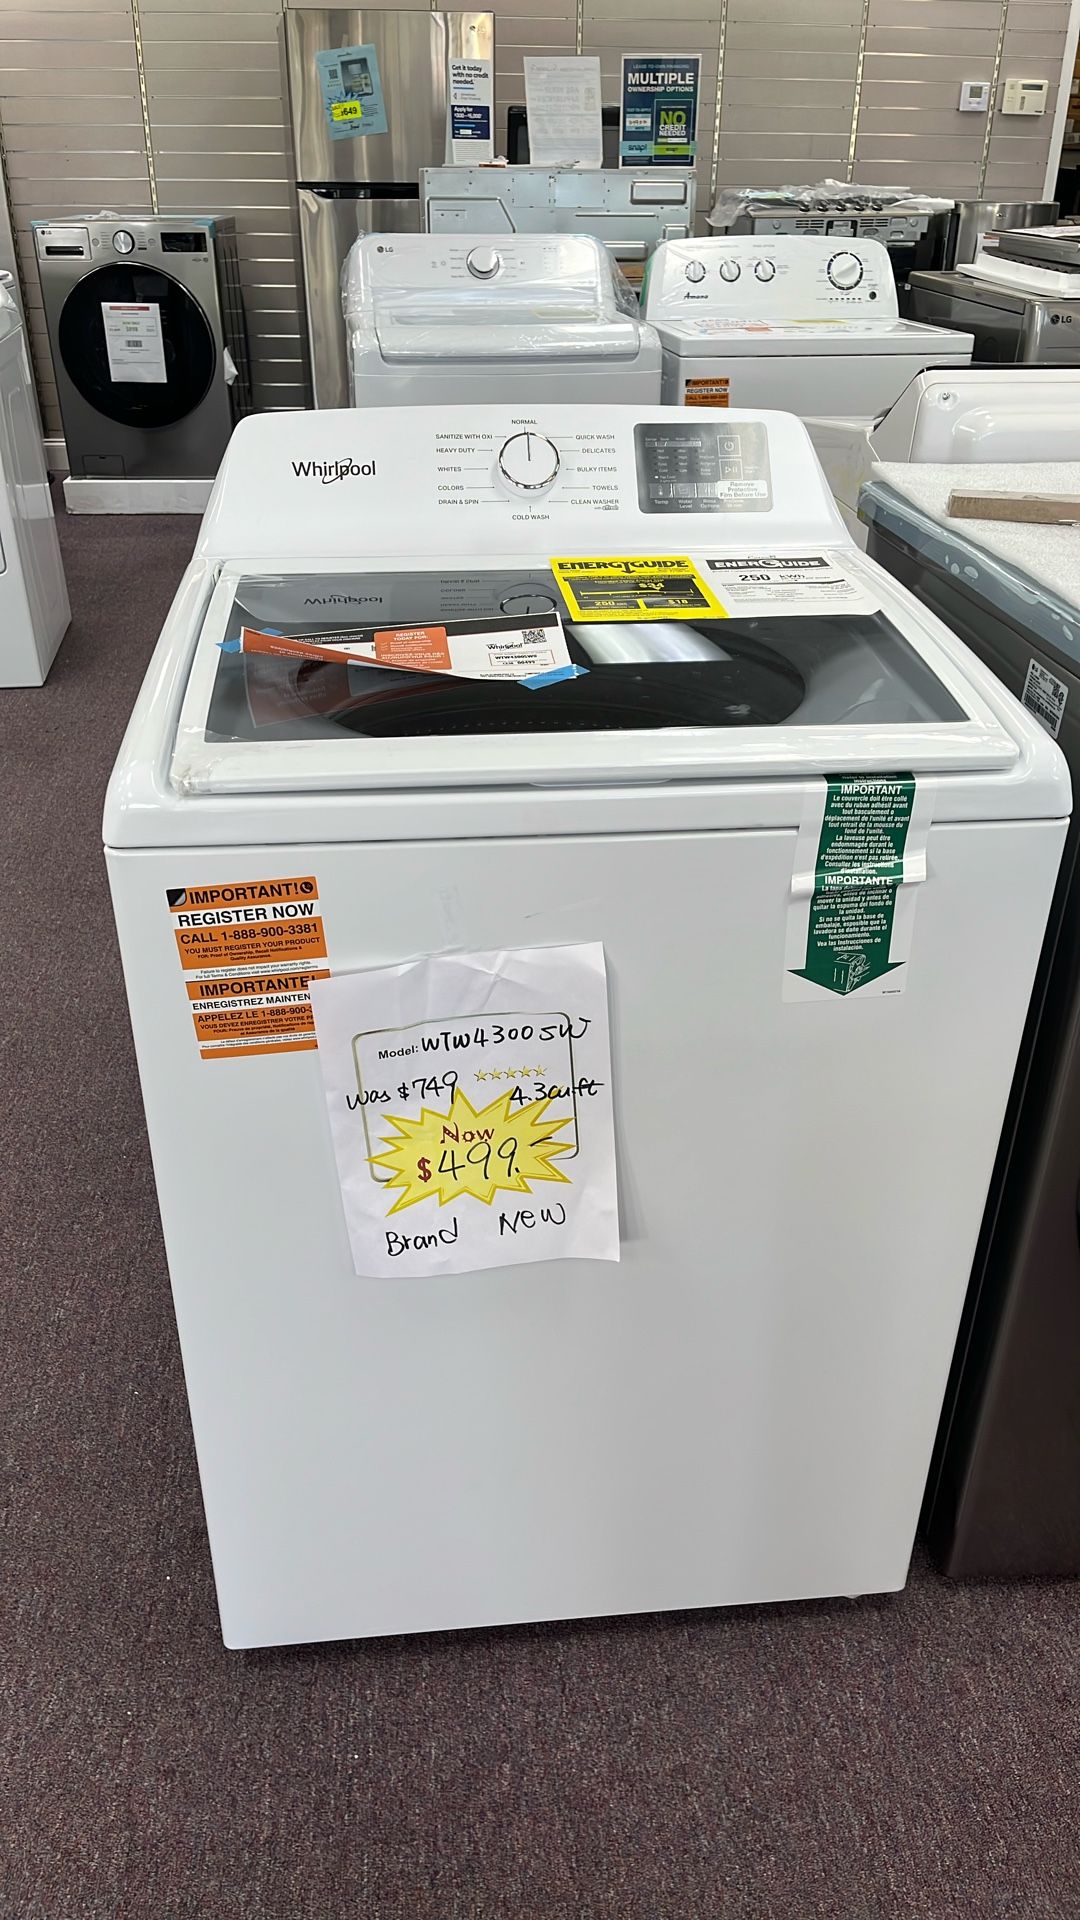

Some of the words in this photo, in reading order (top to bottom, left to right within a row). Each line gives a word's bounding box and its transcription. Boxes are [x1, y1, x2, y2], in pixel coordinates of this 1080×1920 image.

[628, 73, 694, 84] MULTIPLE
[661, 111, 686, 125] NO
[292, 458, 376, 484] Whirlpool
[841, 785, 902, 794] IMPORTANT
[825, 876, 893, 884] IMPORTANTE
[190, 883, 298, 904] IMPORTANT!
[178, 907, 267, 927] REGISTER
[272, 903, 314, 918] NOW
[180, 933, 218, 945] CALL
[221, 923, 318, 941] 1-888-900-3381
[223, 942, 261, 951] REGISTER
[261, 940, 283, 948] YOUR
[284, 937, 320, 946] PRODUCT
[192, 997, 264, 1010] ENREGISTREZ
[265, 993, 311, 1004] MAINTEN
[198, 1012, 244, 1022] APPELEZ
[240, 1018, 283, 1026] ENREGISTRER
[378, 1045, 419, 1060] Model:
[397, 1070, 458, 1104] $749
[440, 1122, 494, 1144] Now
[386, 1216, 458, 1256] Brand
[500, 1202, 566, 1236] New
